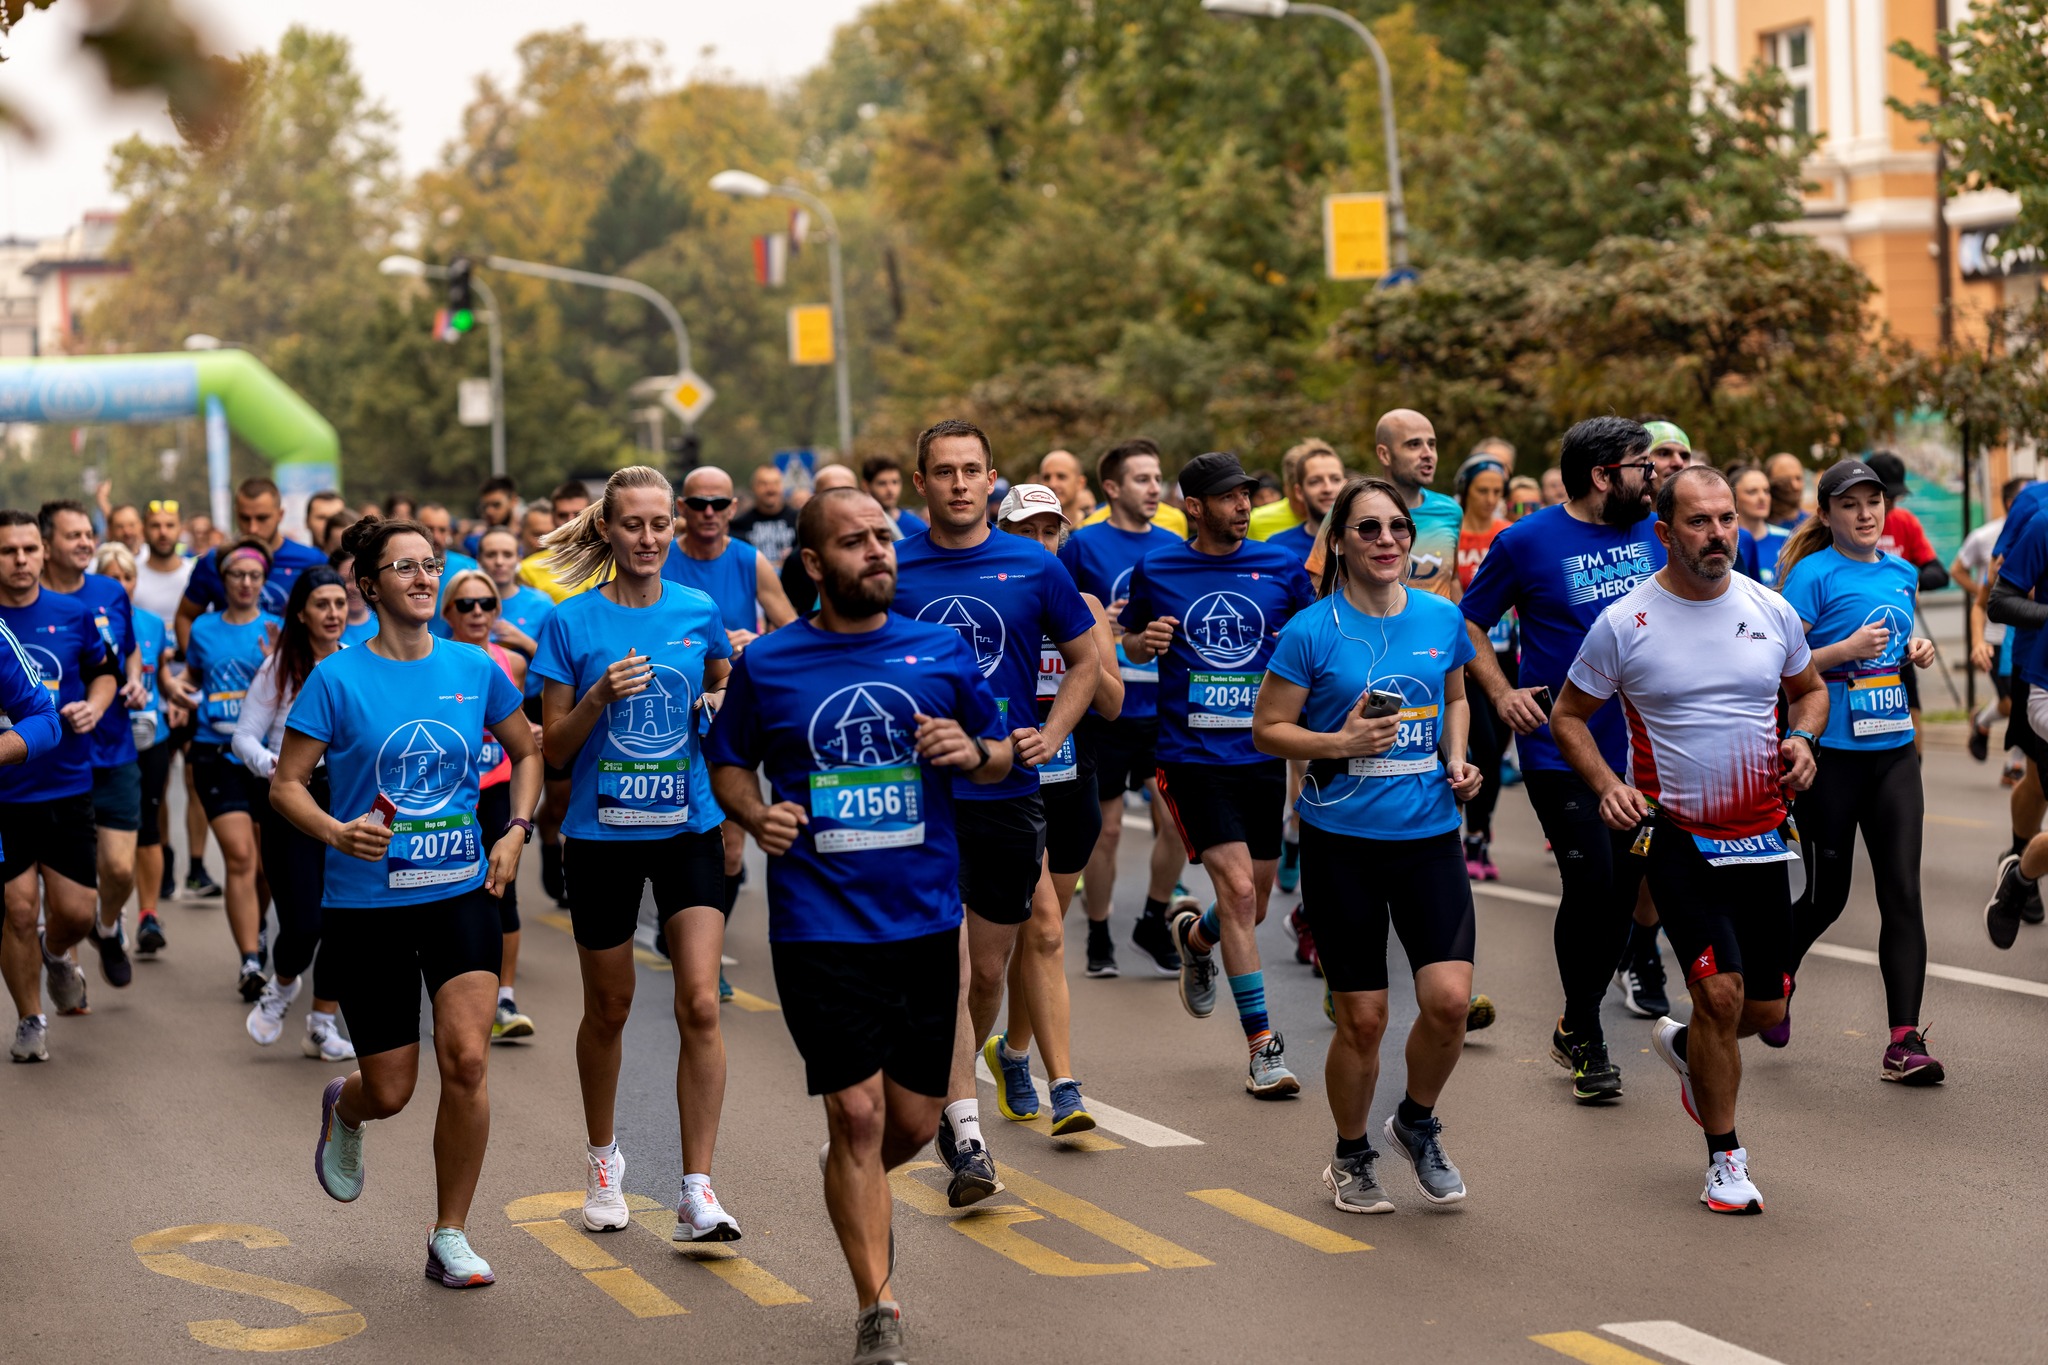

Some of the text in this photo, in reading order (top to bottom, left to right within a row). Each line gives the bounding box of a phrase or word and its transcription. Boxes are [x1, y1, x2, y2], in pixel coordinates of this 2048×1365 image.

[1578, 544, 1641, 570] I'M THE
[1573, 557, 1651, 589] RUNNING
[1593, 575, 1639, 599] HERO
[1229, 675, 1246, 683] Canada
[222, 699, 242, 718] 10
[1205, 686, 1251, 707] 2034
[1868, 686, 1903, 711] 1190
[1396, 722, 1424, 747] 34
[634, 763, 659, 771] hipi hopi
[619, 775, 674, 799] 2073
[837, 785, 901, 819] 2156
[393, 822, 403, 832] 21
[425, 820, 447, 829] Hop cup
[410, 830, 463, 860] 2072
[1713, 834, 1766, 853] 2087
